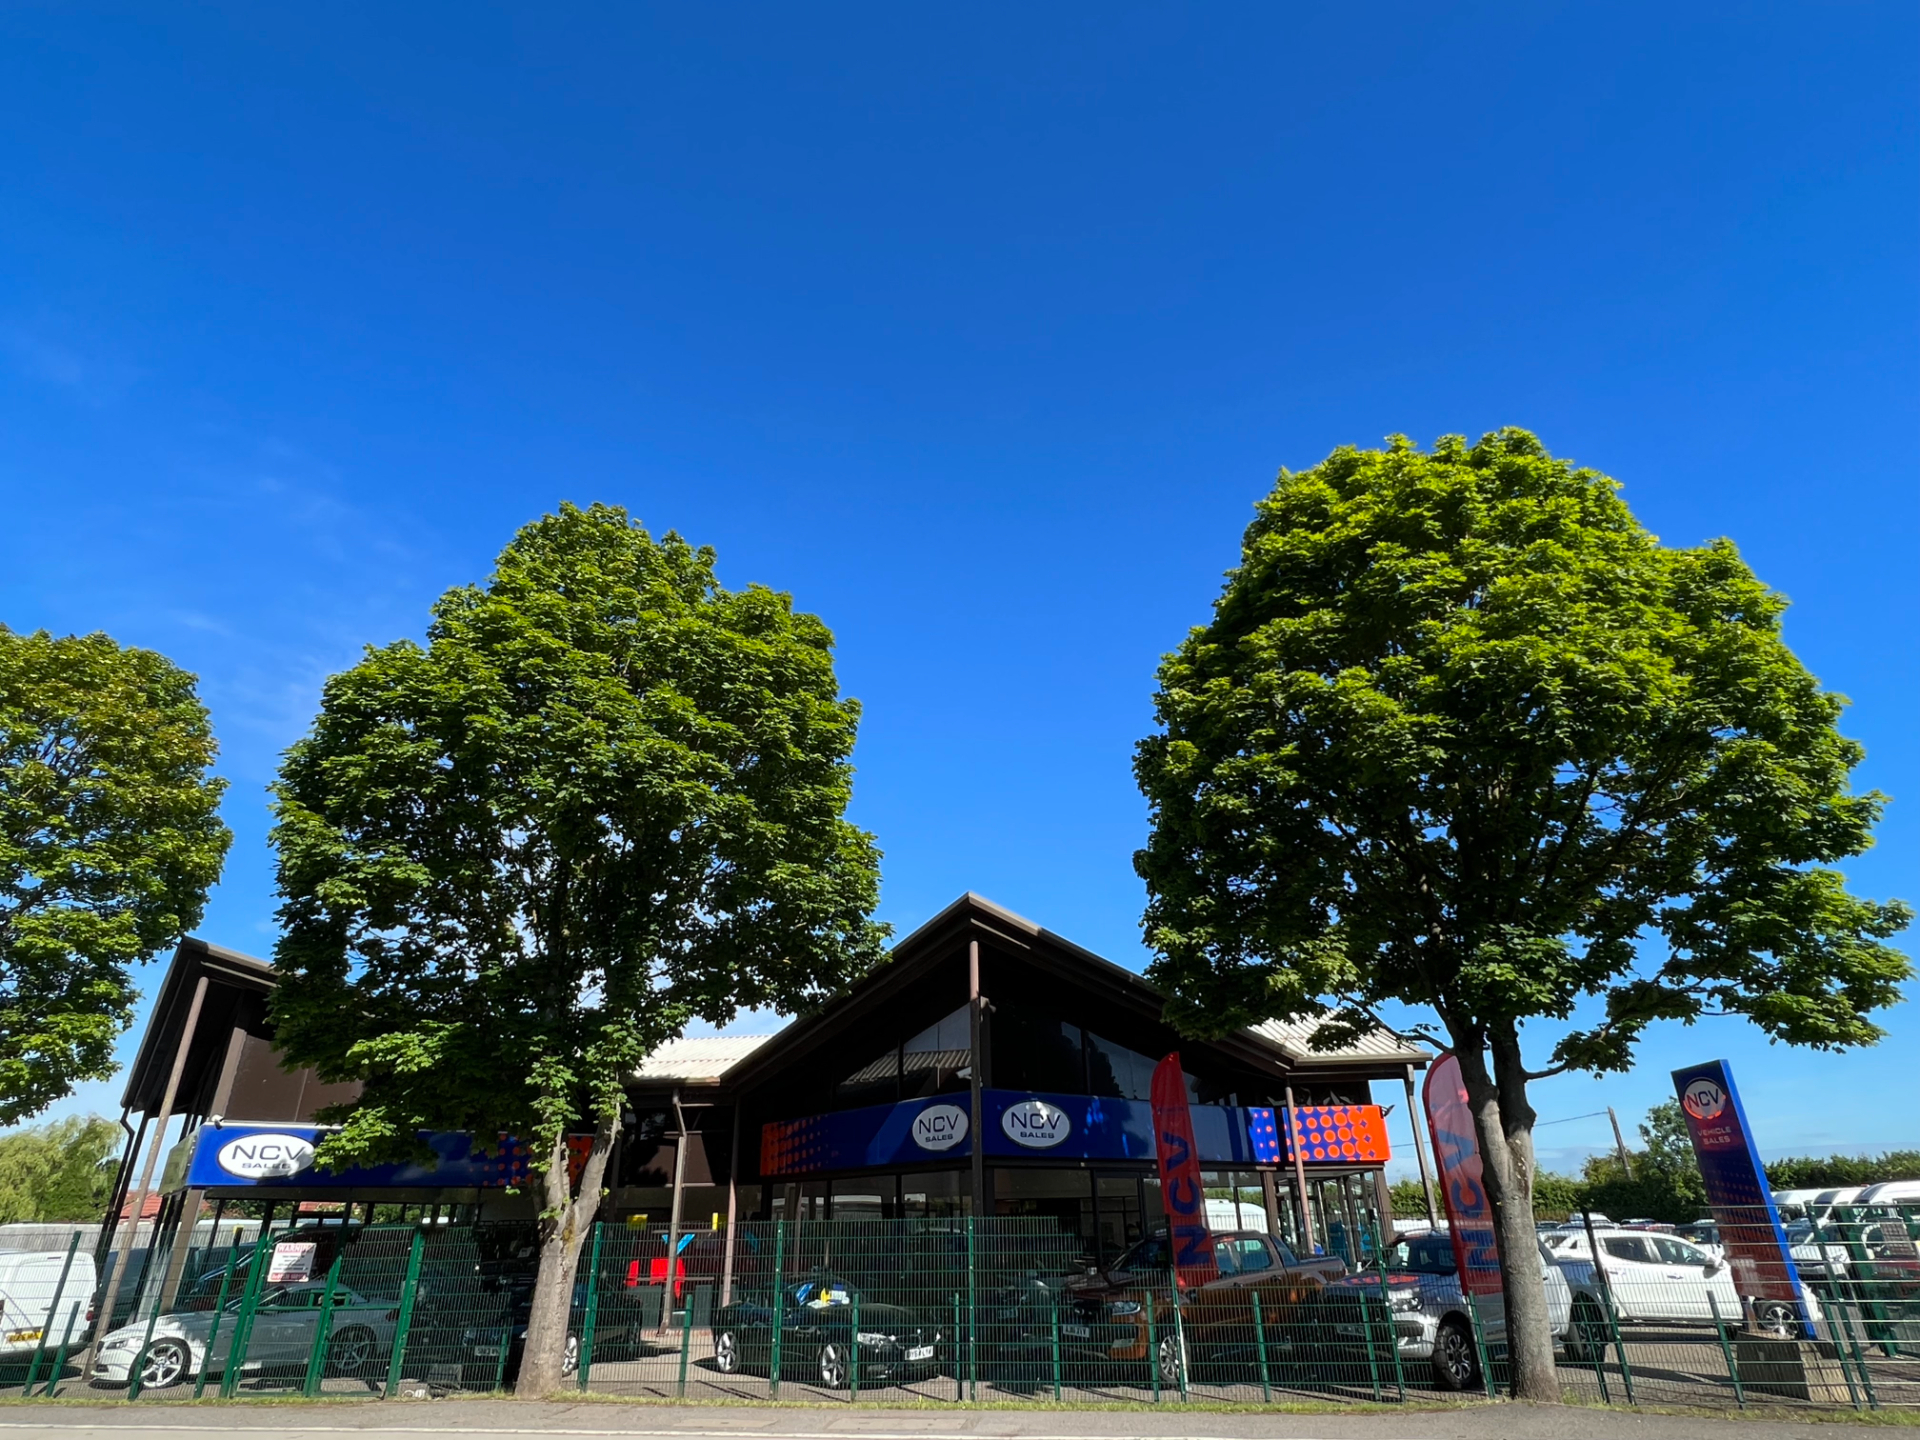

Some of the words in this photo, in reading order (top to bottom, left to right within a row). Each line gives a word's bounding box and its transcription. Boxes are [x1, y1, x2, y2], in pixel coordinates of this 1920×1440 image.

[1686, 1088, 1719, 1108] NCV
[918, 1114, 959, 1134] NCV
[1010, 1112, 1061, 1130] NCV
[925, 1133, 954, 1143] SALES
[1019, 1131, 1056, 1139] SALES
[1697, 1126, 1732, 1137] VEHICLE
[1703, 1135, 1731, 1145] SALES
[231, 1144, 306, 1160] NCV
[1162, 1131, 1210, 1266] NCV
[1436, 1128, 1500, 1271] NCV
